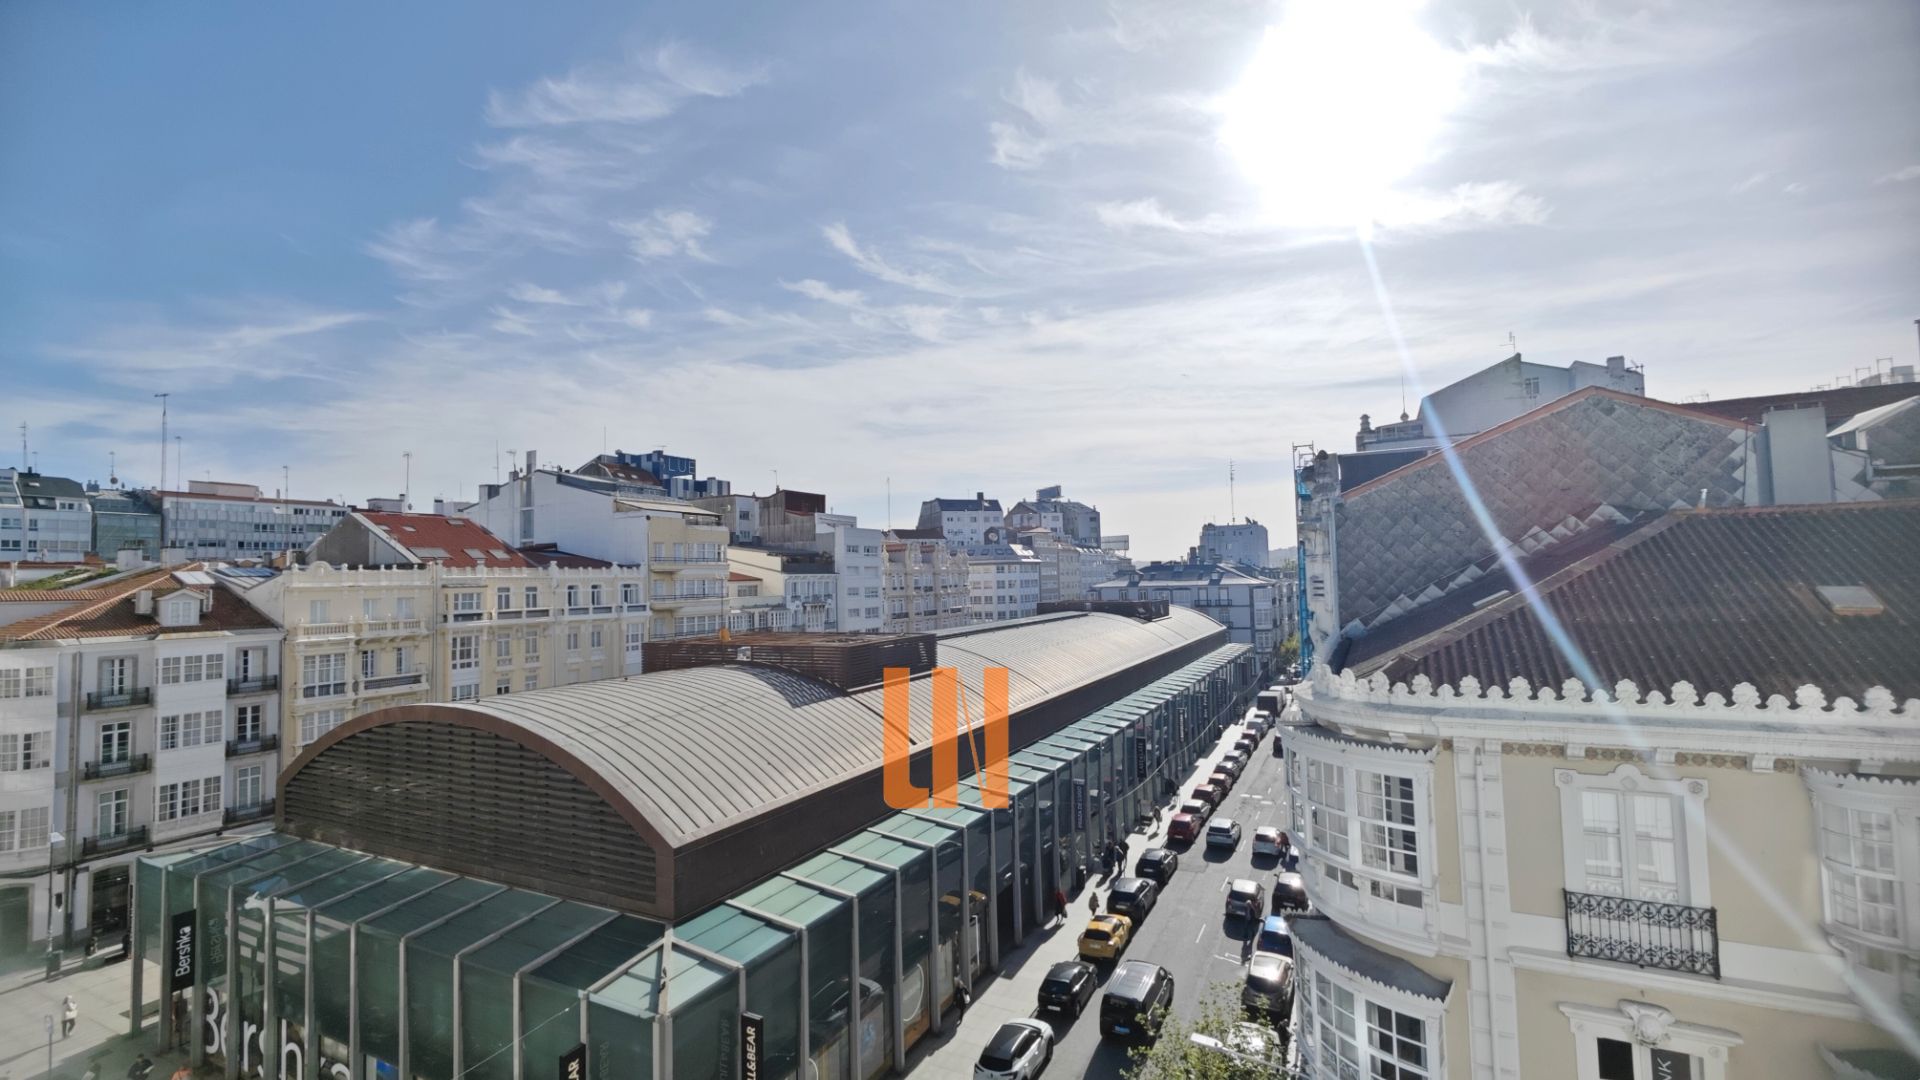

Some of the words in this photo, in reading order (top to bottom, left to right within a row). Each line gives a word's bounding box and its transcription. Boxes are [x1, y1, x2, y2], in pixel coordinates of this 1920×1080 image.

[663, 457, 695, 474] LUE
[175, 925, 192, 977] Bershka
[568, 1058, 579, 1080] AR
